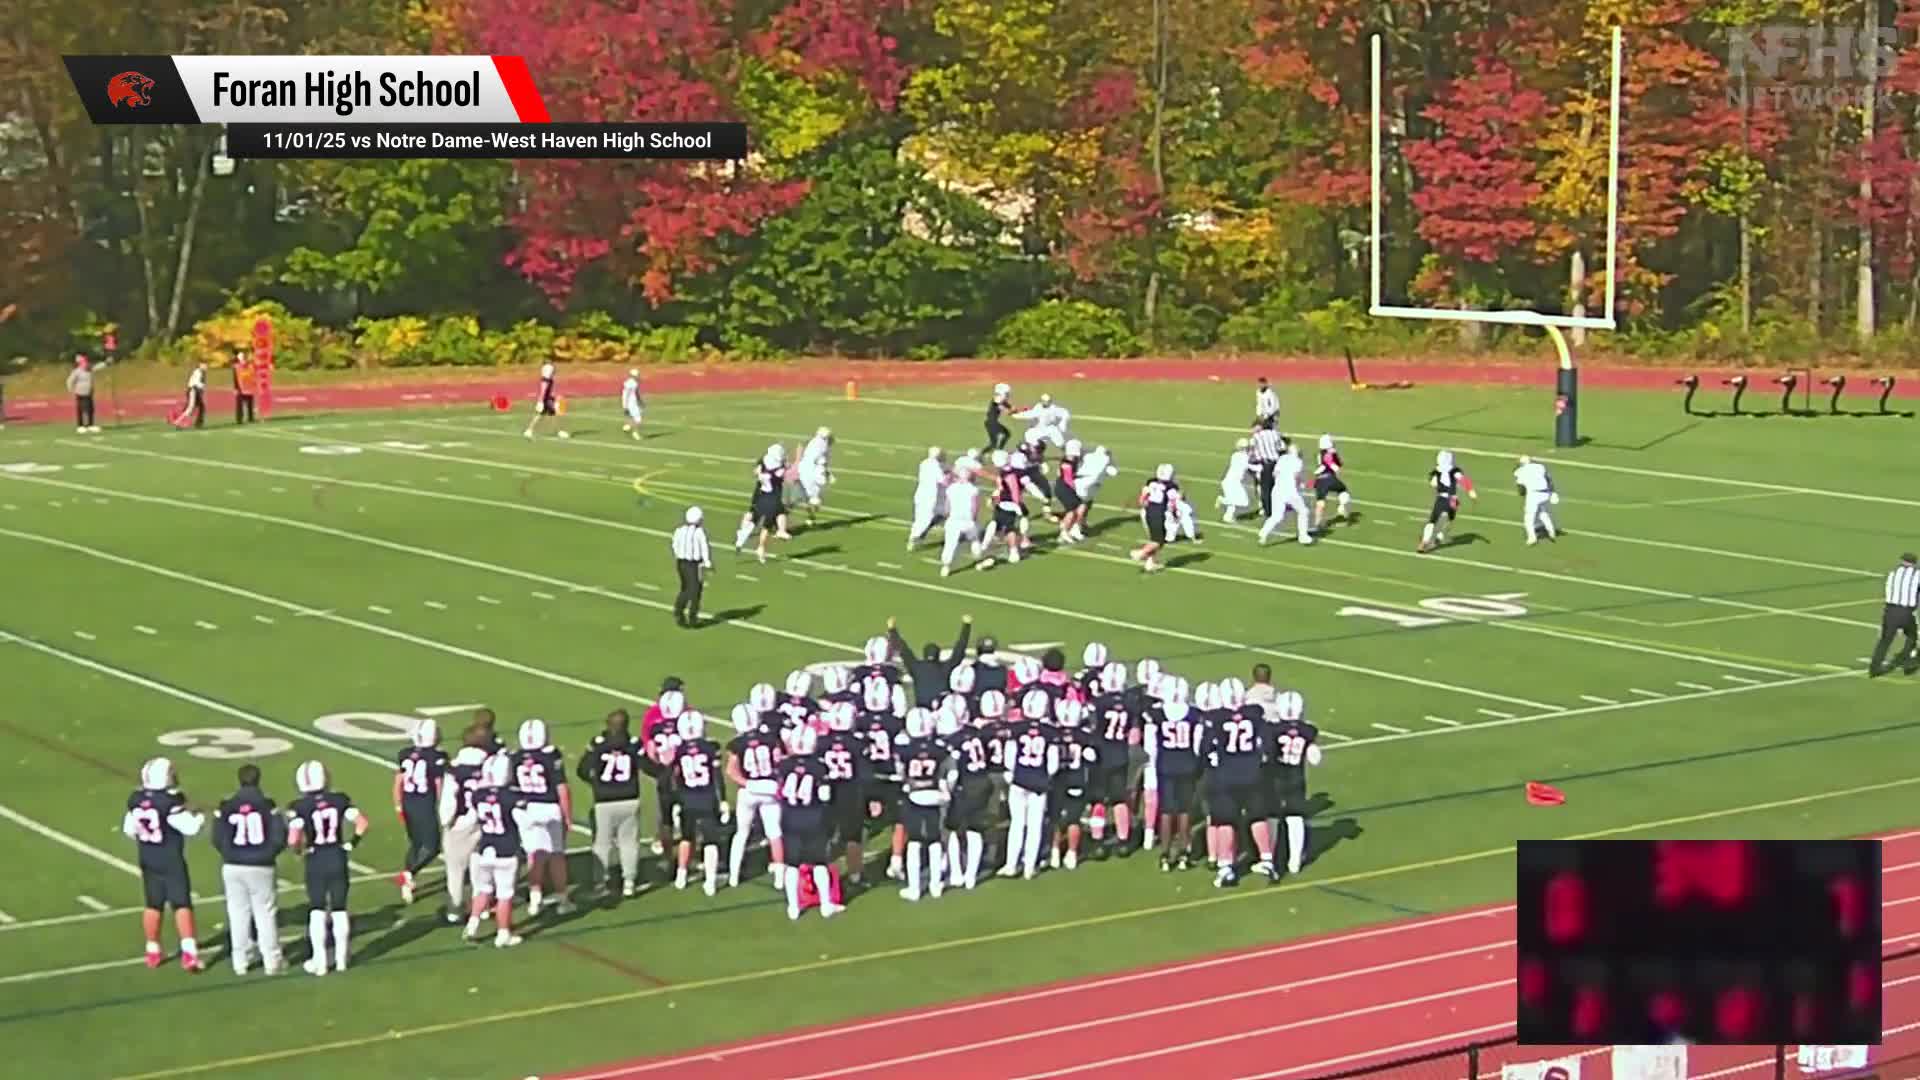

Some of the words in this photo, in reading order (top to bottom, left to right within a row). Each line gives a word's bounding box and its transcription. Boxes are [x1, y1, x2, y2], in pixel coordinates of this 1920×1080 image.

[1161, 720, 1190, 749] 50
[1223, 719, 1253, 753] 72
[600, 753, 631, 782] 79
